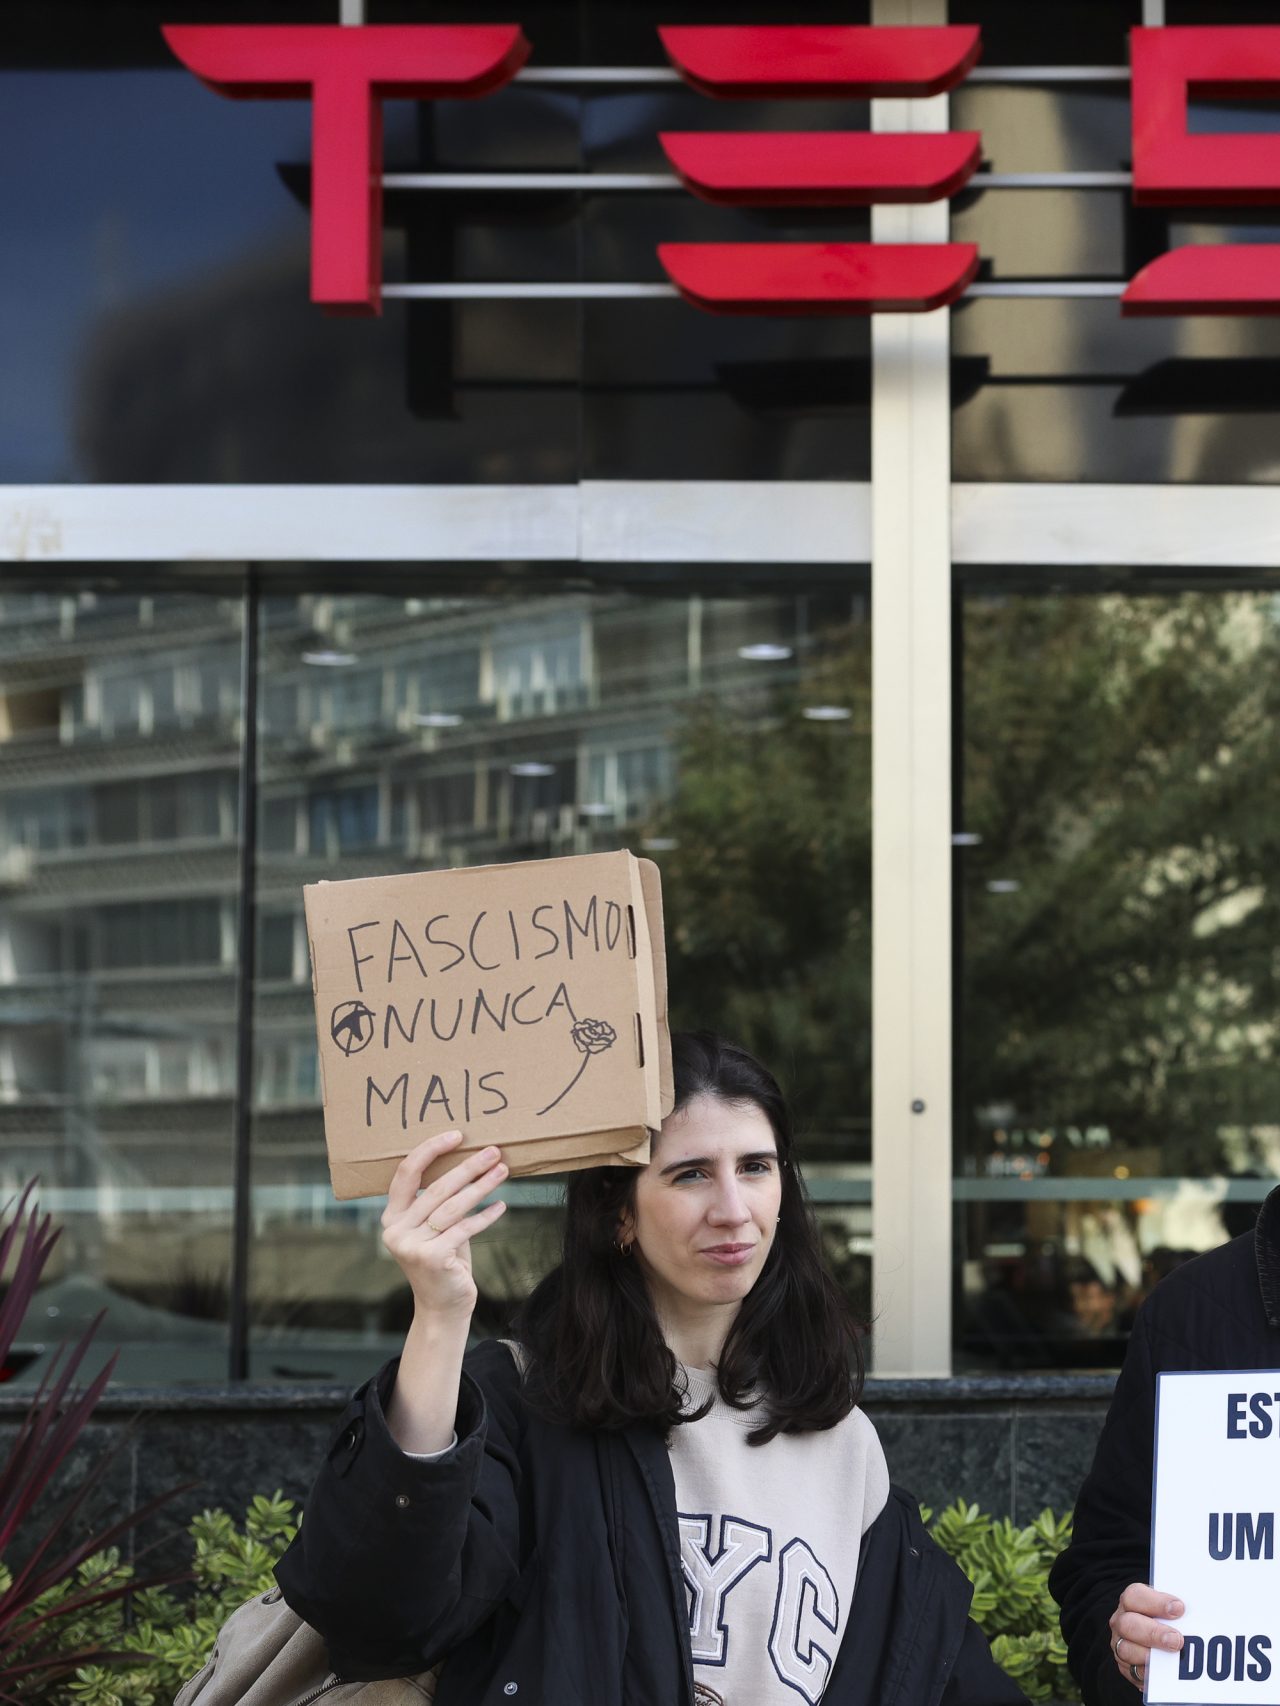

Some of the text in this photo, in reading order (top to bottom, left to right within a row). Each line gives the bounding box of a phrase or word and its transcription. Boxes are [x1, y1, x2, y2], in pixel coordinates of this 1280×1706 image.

[347, 895, 622, 992] FASCISMO
[383, 982, 578, 1049] NUNCA
[365, 1069, 508, 1129] MAIS
[1208, 1512, 1274, 1561] UM
[1178, 1634, 1273, 1682] DOIS
